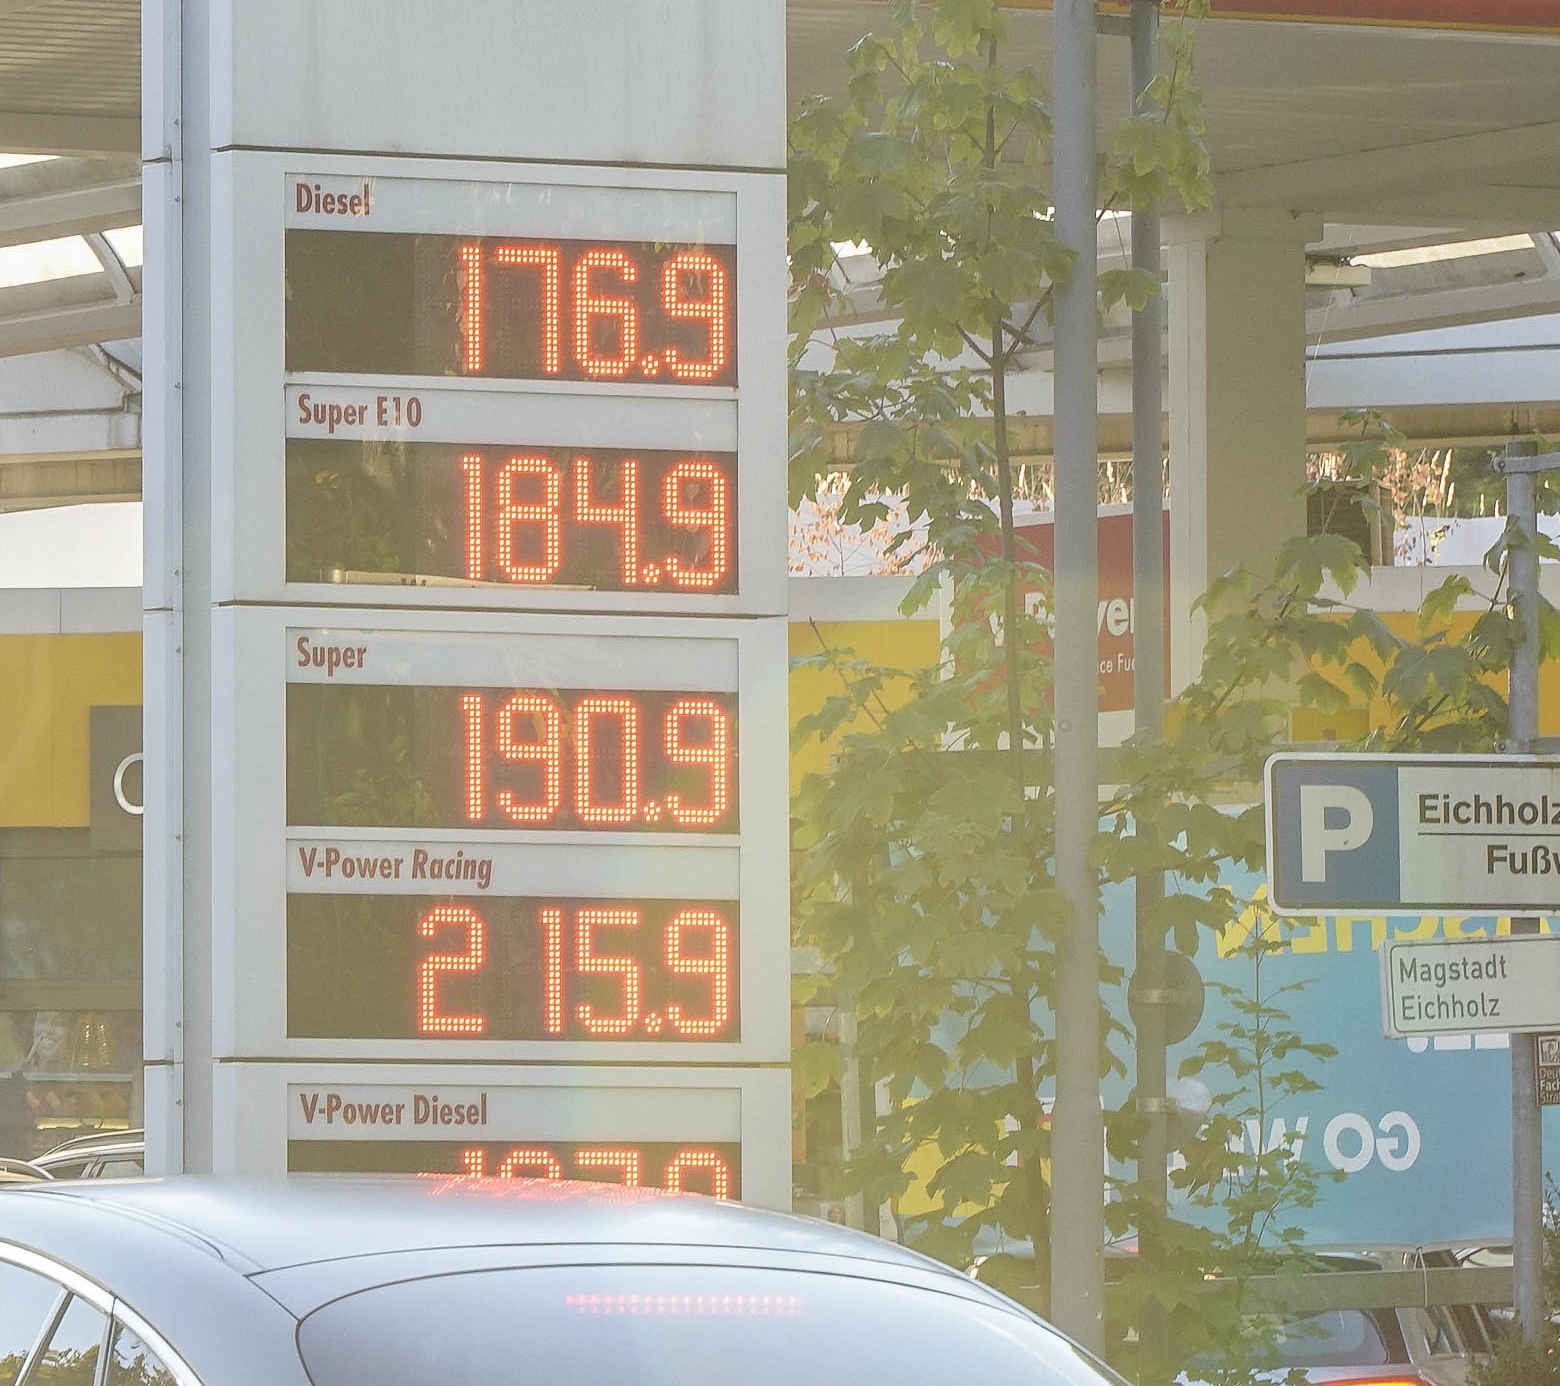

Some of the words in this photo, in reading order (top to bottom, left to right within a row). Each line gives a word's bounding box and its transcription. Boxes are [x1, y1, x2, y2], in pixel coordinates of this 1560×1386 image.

[296, 183, 370, 215] Diesel
[460, 244, 726, 379] 176.9
[298, 394, 367, 433] Super
[376, 396, 422, 427] E10
[462, 455, 727, 587] 184.9
[297, 637, 367, 676] Super
[462, 694, 728, 824] 190.9
[1300, 785, 1374, 883] P
[299, 847, 404, 879] V-Power
[411, 849, 494, 889] Racing
[1399, 954, 1507, 987] Magstadt
[1401, 992, 1500, 1021] Eichholz
[300, 1093, 406, 1125] V-Power
[414, 1093, 487, 1126] Diesel
